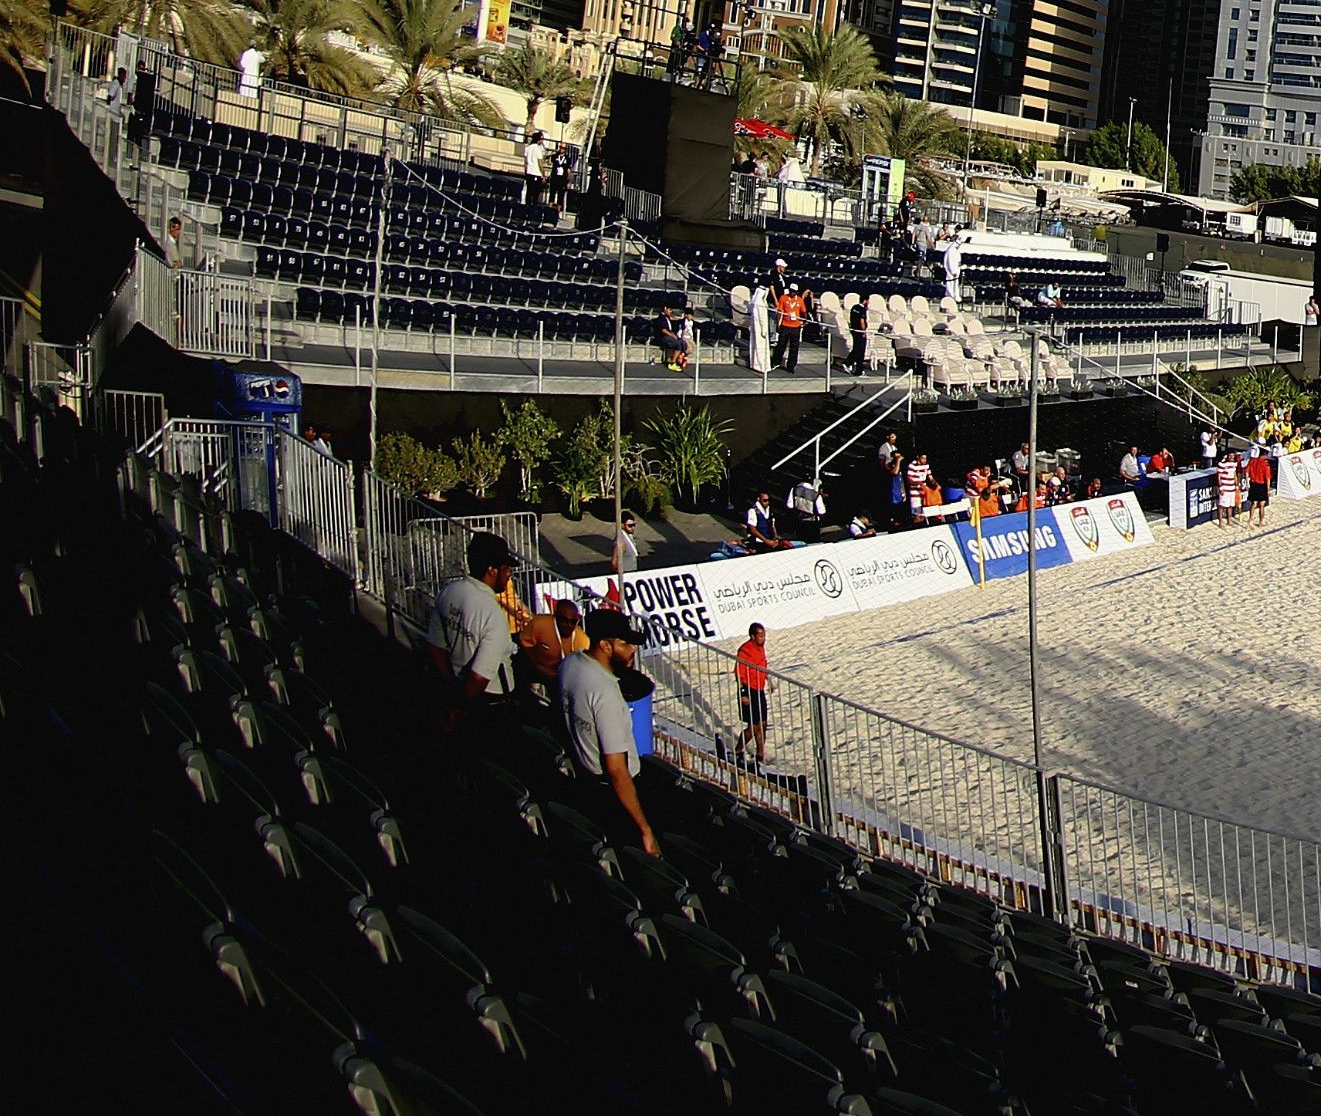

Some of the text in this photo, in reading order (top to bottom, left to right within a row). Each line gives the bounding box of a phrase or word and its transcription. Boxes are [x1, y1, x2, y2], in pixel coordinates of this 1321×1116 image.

[967, 525, 1057, 562] SAMSUNG
[713, 572, 811, 601] مجلس دبي الرياضي
[852, 564, 935, 590] DUBAI SPORTS COUNCIL
[623, 573, 703, 616] POWER
[718, 586, 816, 613] DUBAI SPORTS COUNCIL
